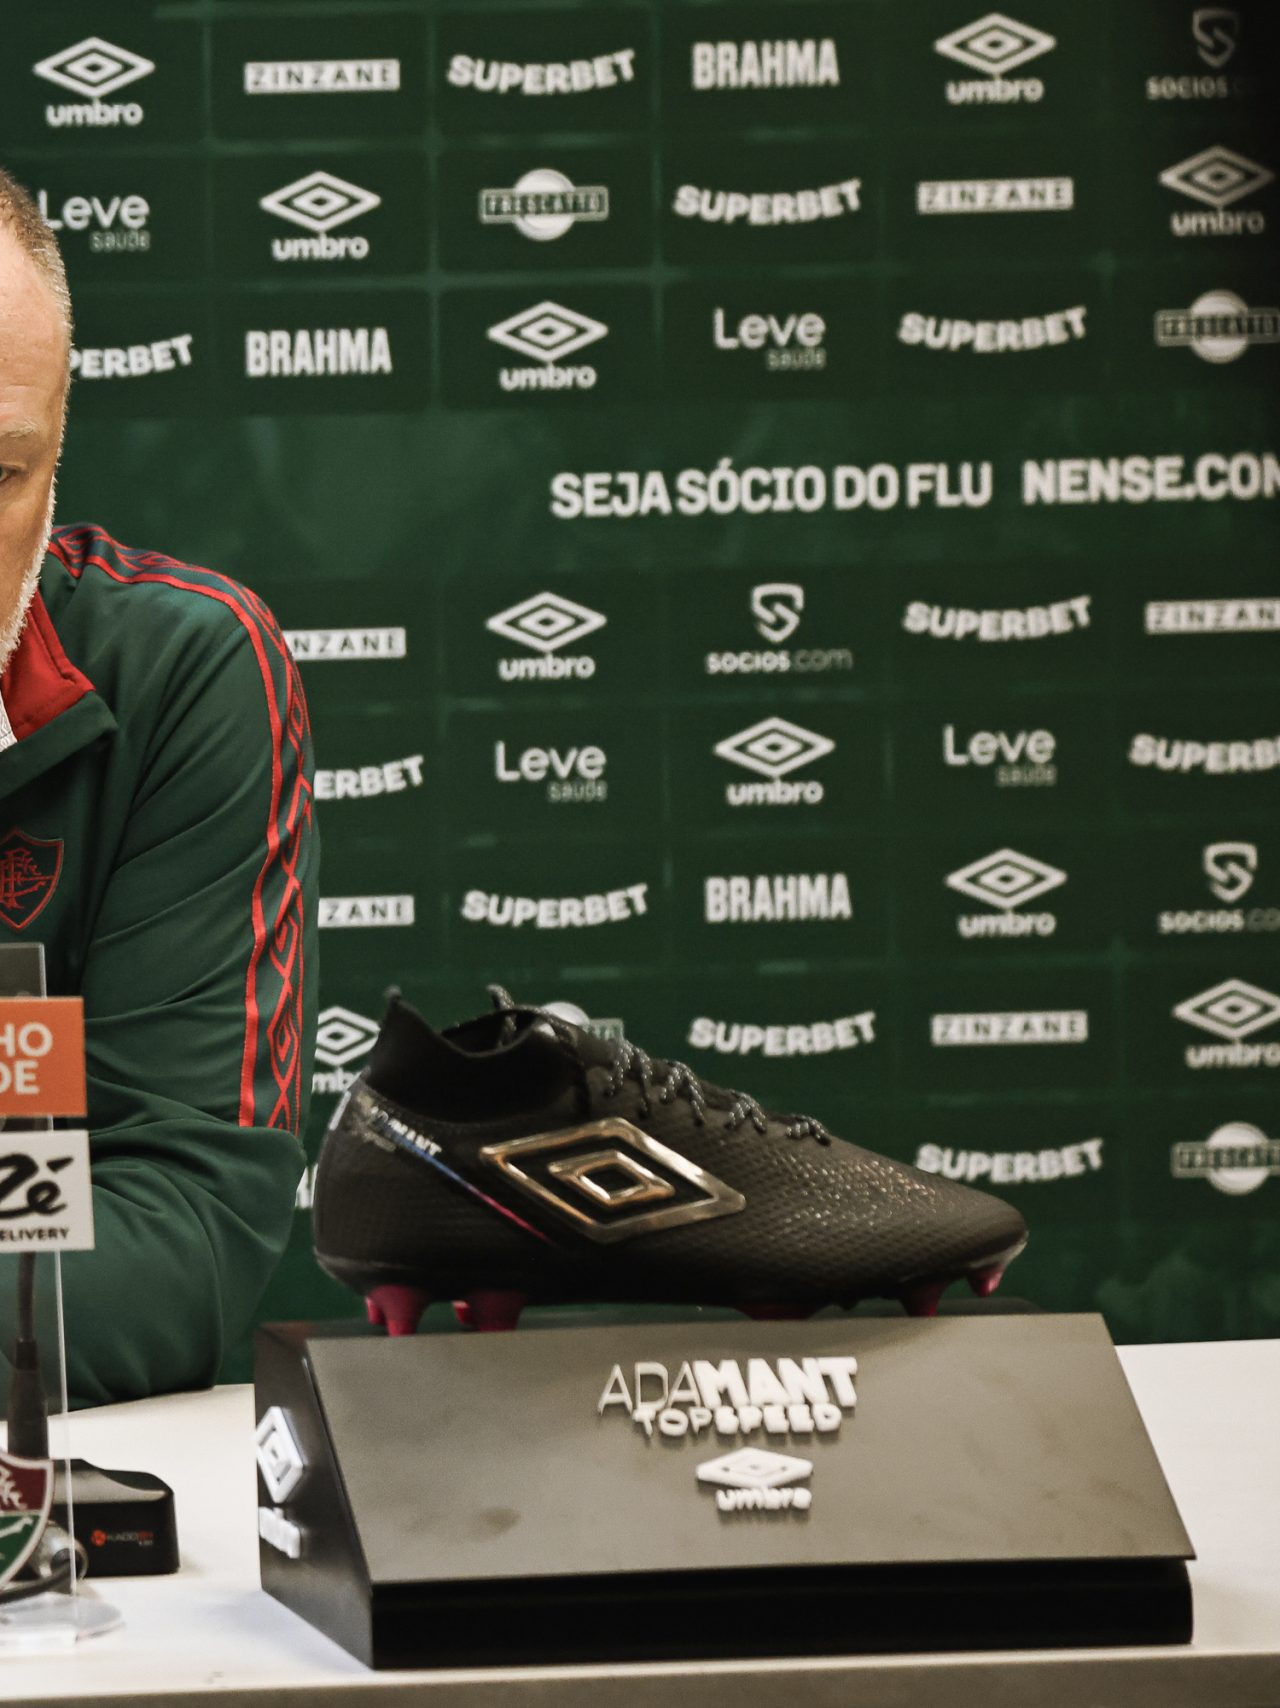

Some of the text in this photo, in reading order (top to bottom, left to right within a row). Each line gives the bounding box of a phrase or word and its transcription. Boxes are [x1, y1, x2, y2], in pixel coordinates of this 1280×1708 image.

[447, 49, 634, 94] SUPERBET
[692, 39, 839, 89] BRAHMA
[946, 76, 1044, 104] umbro
[46, 99, 143, 127] umbro
[36, 188, 151, 231] Leve
[673, 179, 860, 225] SUPERBET
[1170, 208, 1263, 236] umbro
[272, 232, 369, 261] umbro
[714, 308, 825, 348] Leve
[898, 307, 1086, 352] SUPERBET
[246, 328, 392, 377] BRAHMA
[499, 362, 597, 391] umbro
[550, 471, 672, 519] SEJA
[676, 457, 825, 515] SÓCIO
[833, 463, 899, 510] DO
[906, 462, 992, 508] FLU
[903, 596, 1090, 641] SUPERBET
[498, 652, 595, 680] umbro
[495, 741, 606, 783] Leve
[943, 725, 1055, 766] Leve
[1129, 734, 1280, 773] SUPERB
[726, 779, 823, 806] umbro
[461, 883, 647, 928] SUPERBET
[705, 873, 852, 922] BRAHMA
[958, 910, 1056, 938] umbro
[688, 1011, 875, 1056] SUPERBET
[915, 1137, 1105, 1185] SUPERBET
[597, 1356, 859, 1417] ADAMANT
